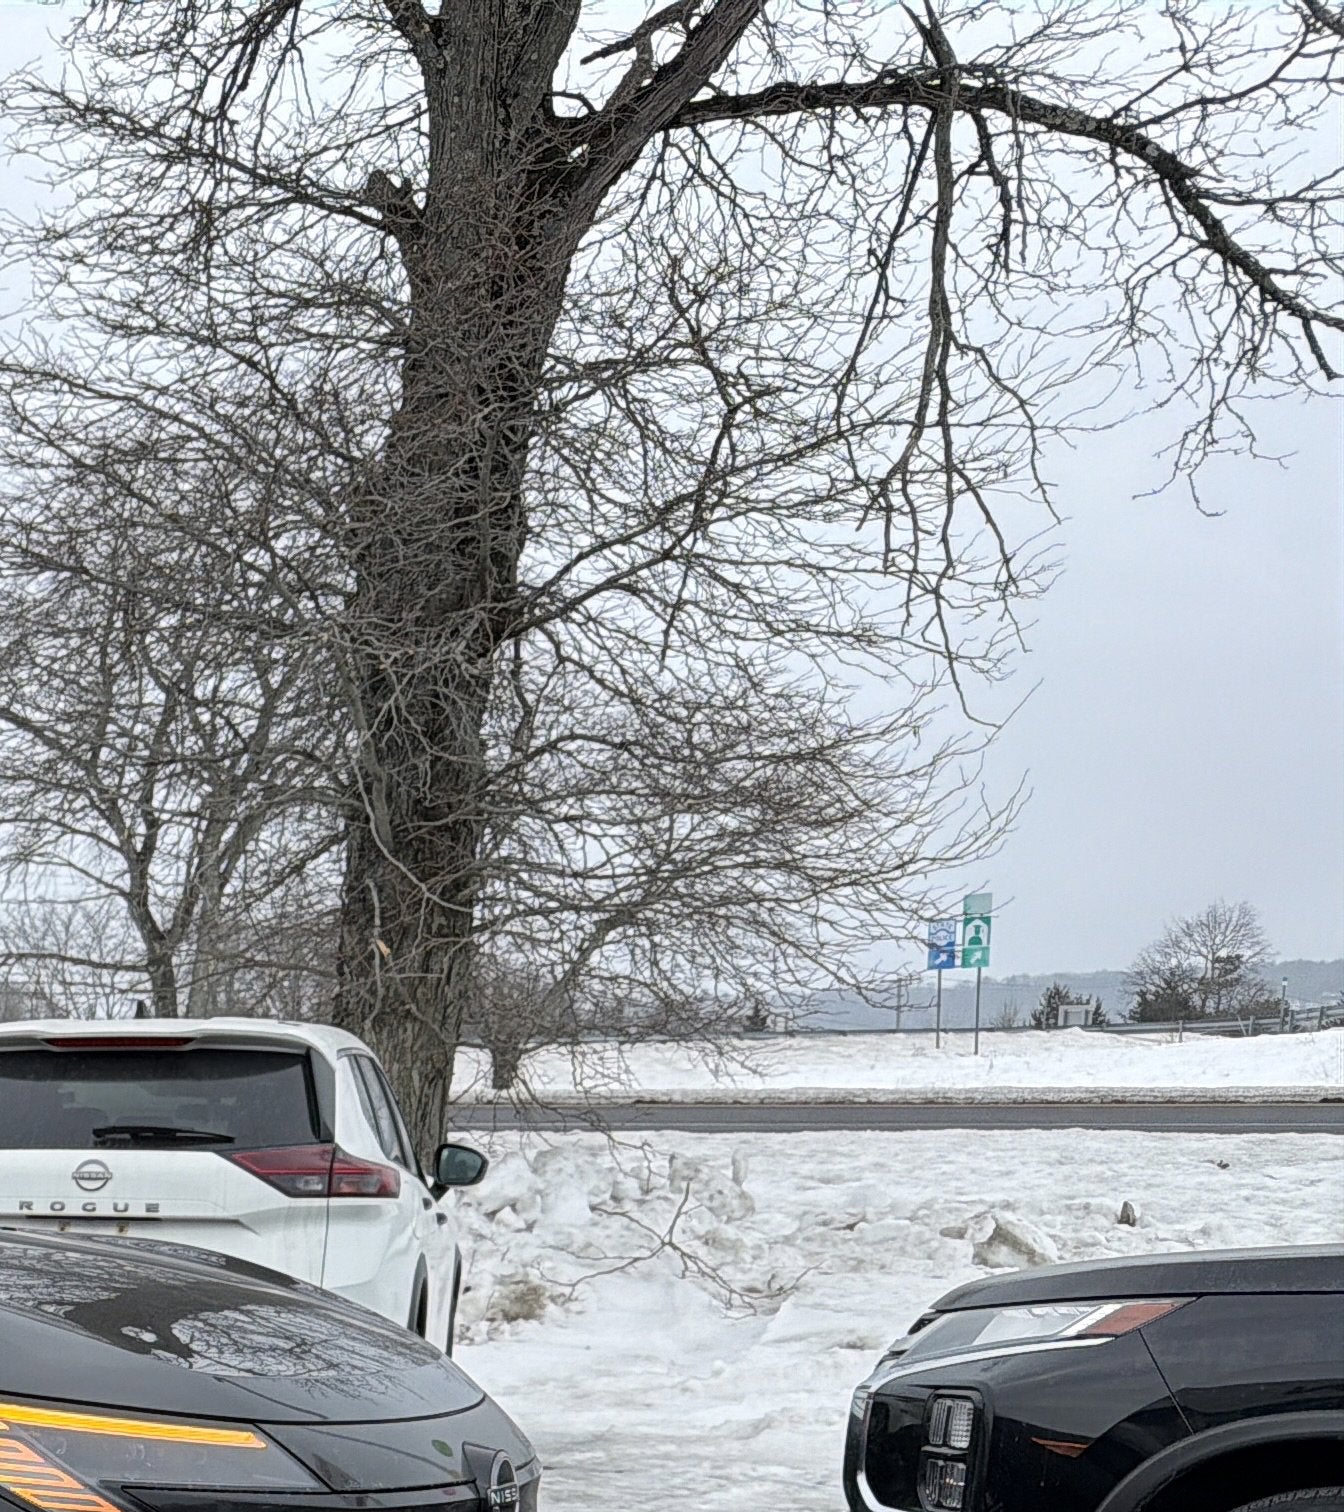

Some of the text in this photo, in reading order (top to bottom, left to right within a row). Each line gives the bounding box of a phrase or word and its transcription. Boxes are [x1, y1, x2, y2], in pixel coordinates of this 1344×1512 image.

[72, 1171, 113, 1181] NISSAN
[18, 1200, 160, 1213] ROGUE
[490, 1486, 519, 1506] NISS
